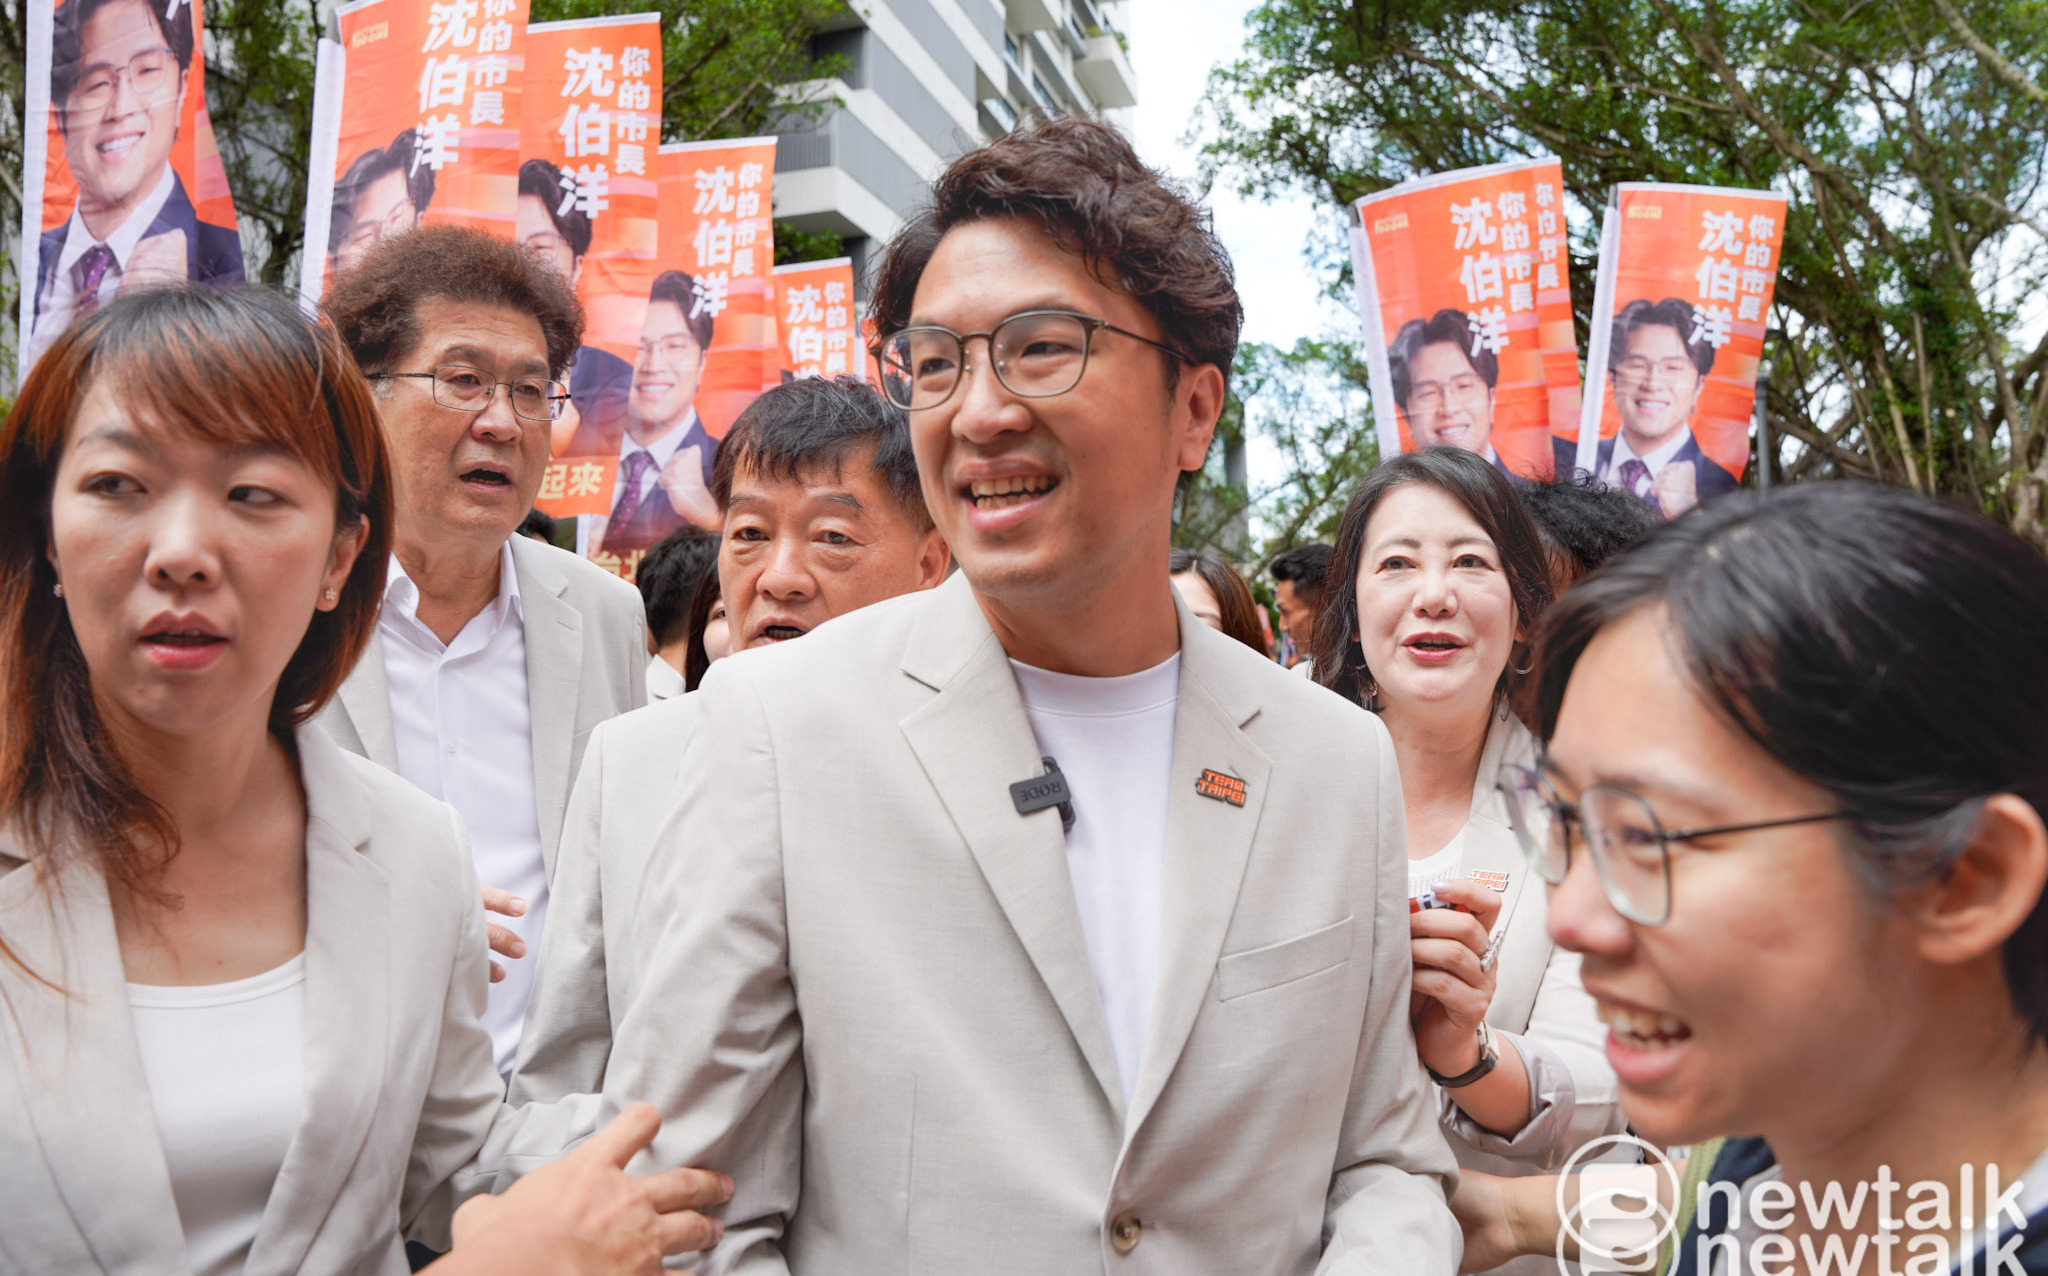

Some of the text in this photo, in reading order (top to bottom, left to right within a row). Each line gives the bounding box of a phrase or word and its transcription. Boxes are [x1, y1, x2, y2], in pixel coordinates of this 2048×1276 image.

[409, 0, 479, 179] 沈伯洋
[557, 47, 615, 219] 沈伯洋
[615, 46, 651, 176] 你的市長
[689, 166, 735, 319] 沈伯洋
[732, 162, 763, 277] 你的市長
[1449, 196, 1510, 358] 沈伯洋
[1497, 191, 1535, 312] 你的市長
[1688, 210, 1744, 350] 沈伯洋
[1737, 214, 1775, 322] 你的市長
[824, 281, 847, 373] 你的市長
[1198, 779, 1246, 804] TAIPEI
[1204, 770, 1244, 792] TEAM
